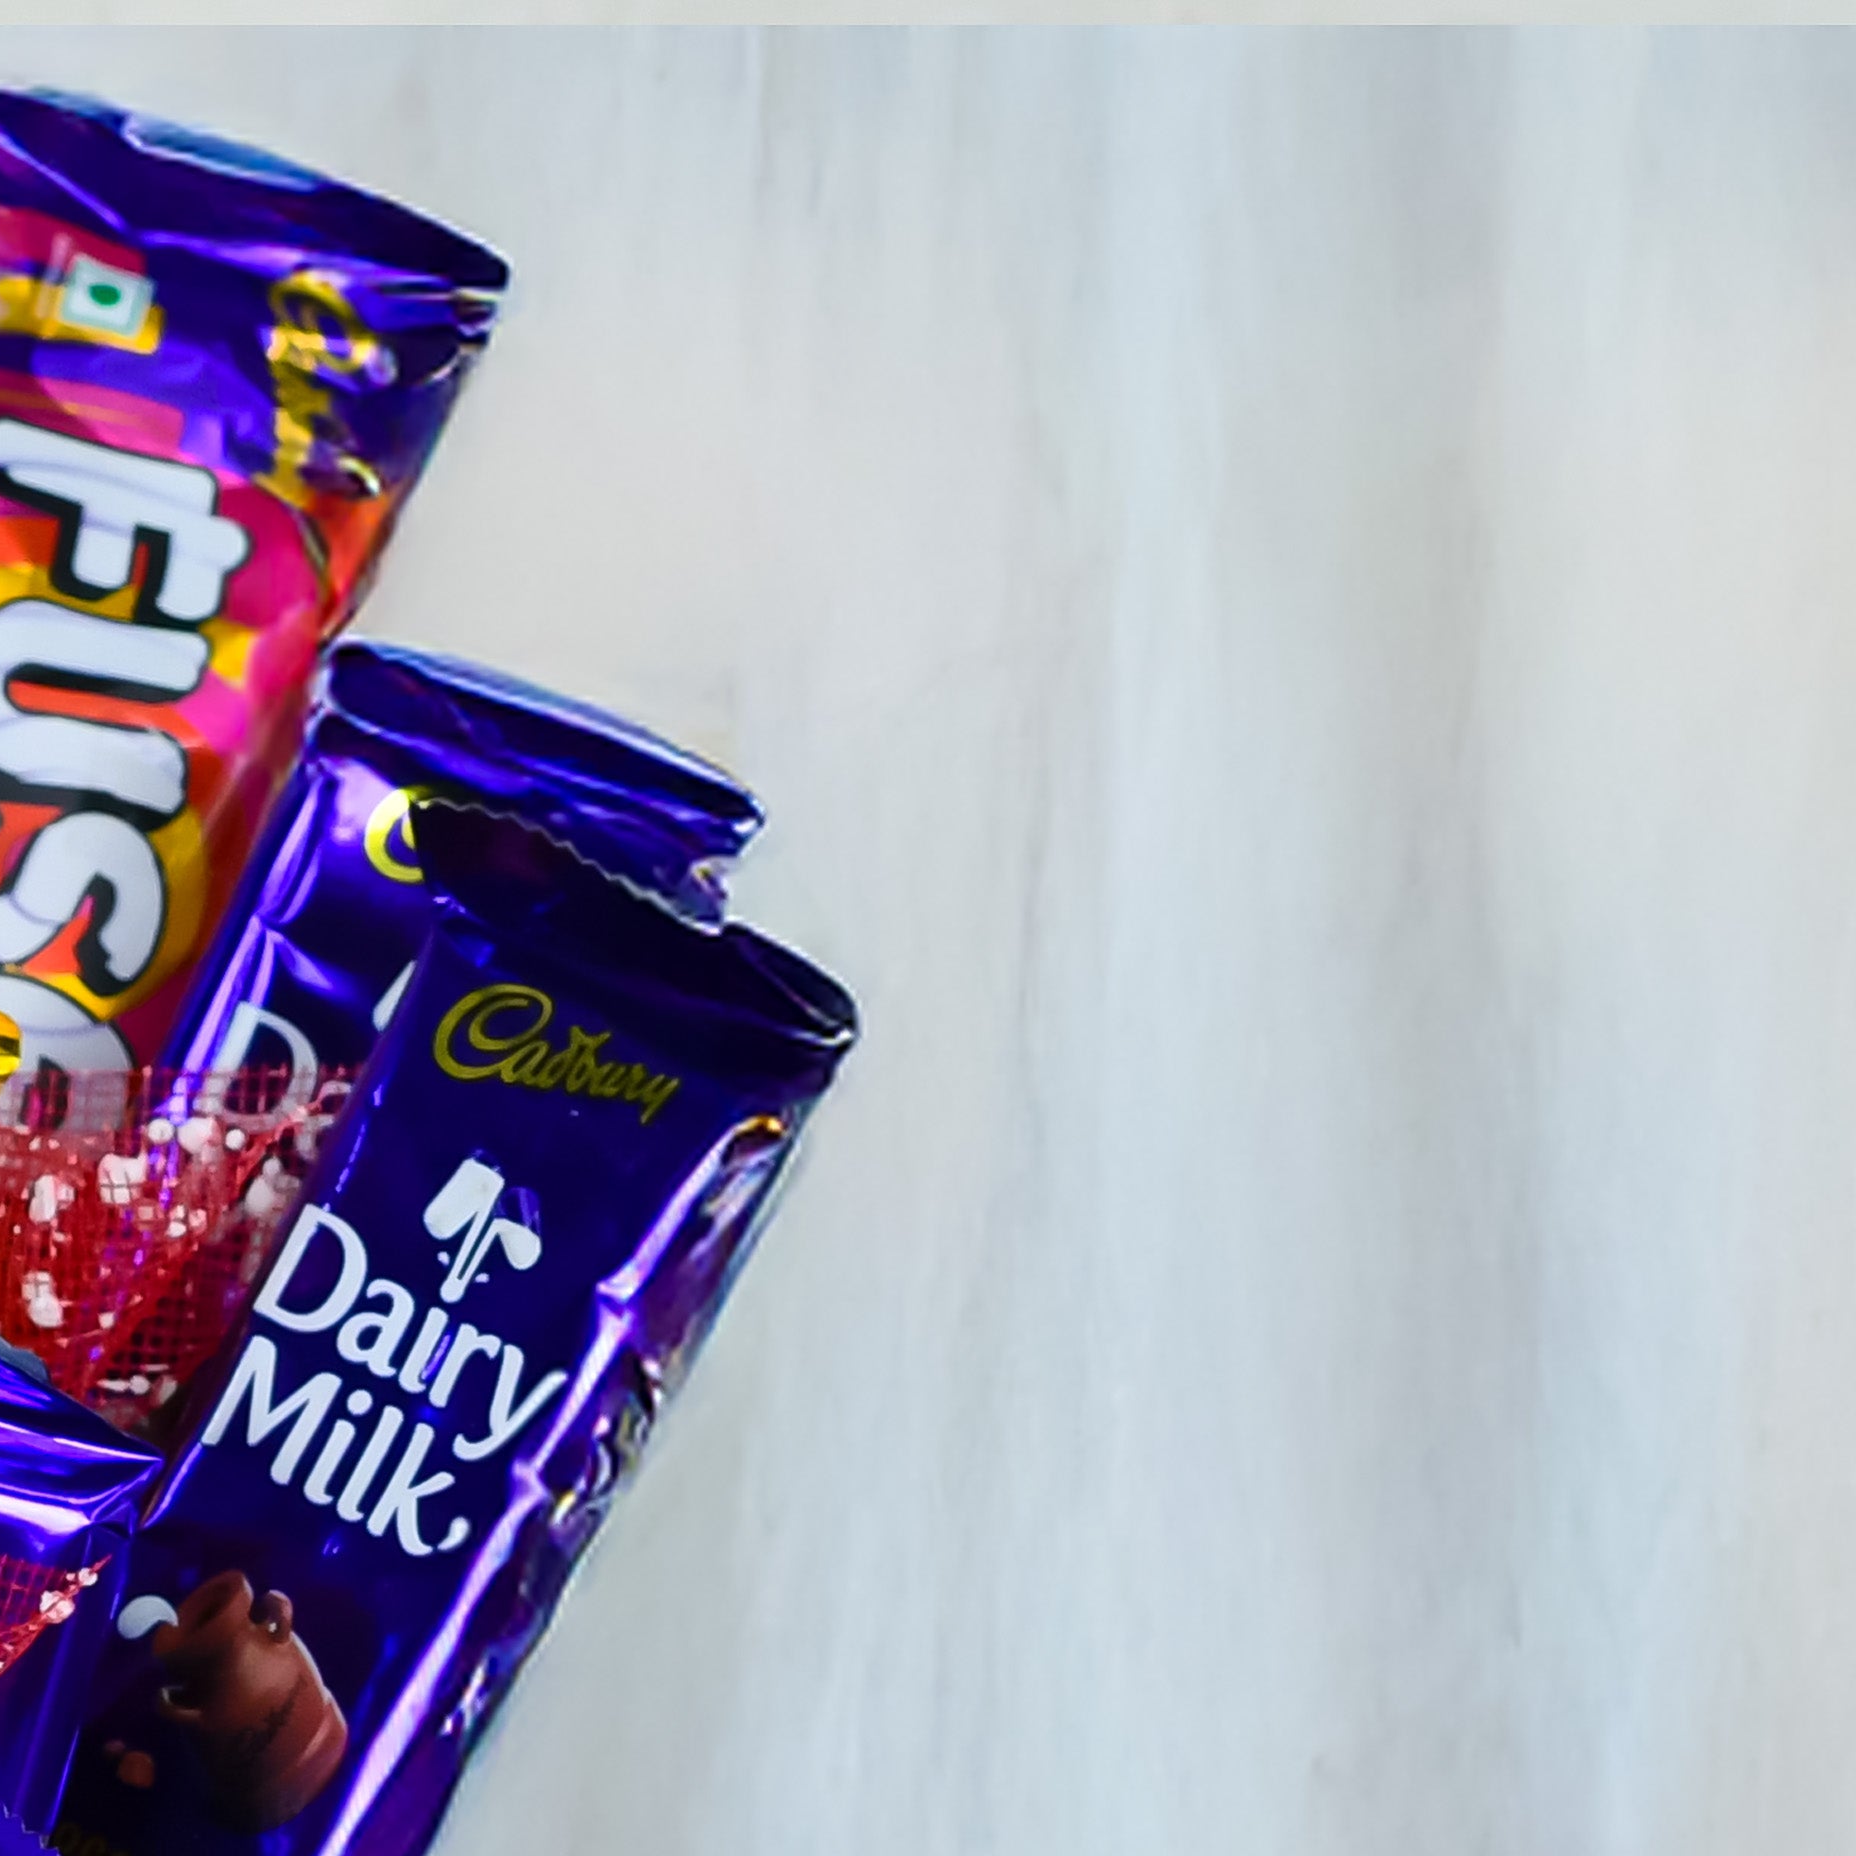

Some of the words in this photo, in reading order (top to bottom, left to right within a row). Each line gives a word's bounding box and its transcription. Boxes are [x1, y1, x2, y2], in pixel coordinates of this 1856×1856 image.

[433, 984, 680, 1124] Cadbury
[253, 1203, 568, 1461] Dairy
[200, 1335, 470, 1556] Milk
